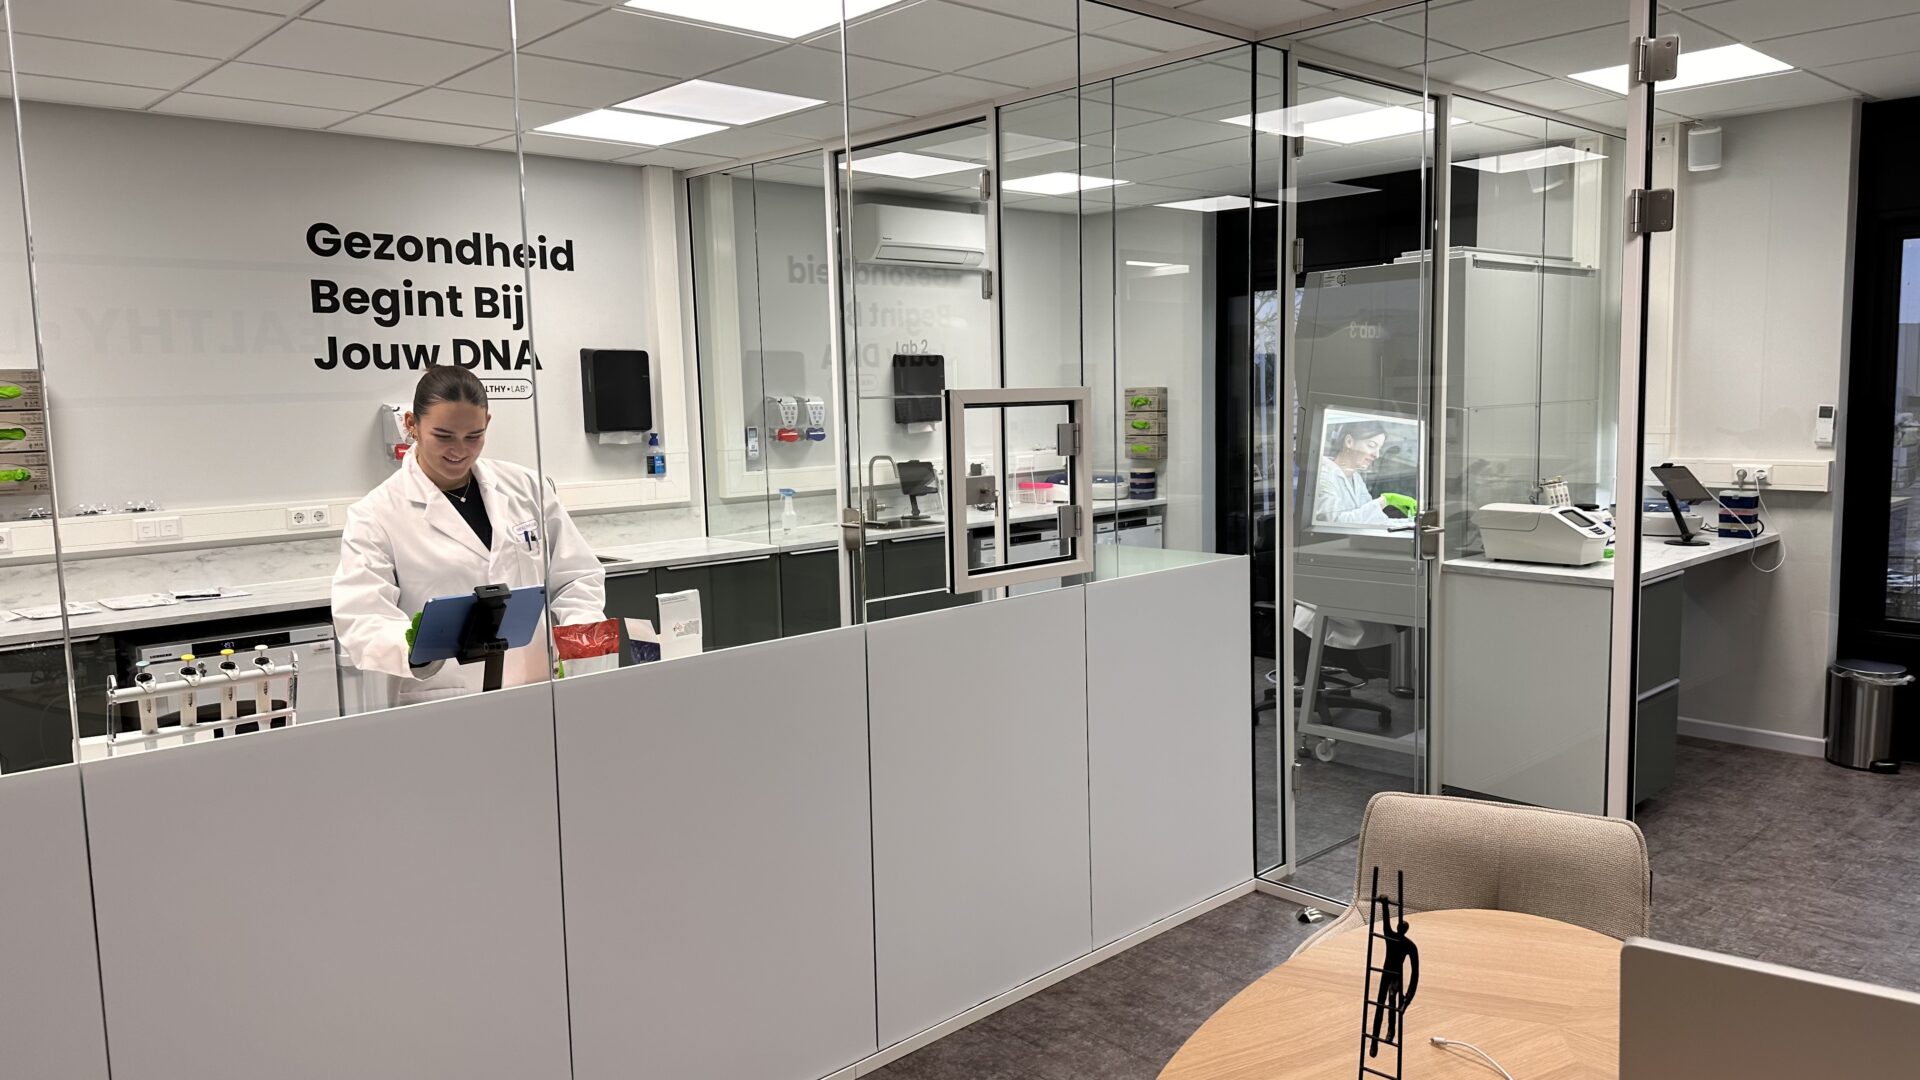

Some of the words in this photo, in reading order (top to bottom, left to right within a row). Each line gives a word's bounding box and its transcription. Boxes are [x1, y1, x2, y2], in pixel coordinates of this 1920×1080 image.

[306, 222, 575, 272] Gezondheid
[310, 278, 464, 328] Begint
[474, 283, 525, 331] Bij
[314, 336, 441, 370] Jouw
[452, 338, 544, 371] DNA
[920, 339, 929, 354] 2
